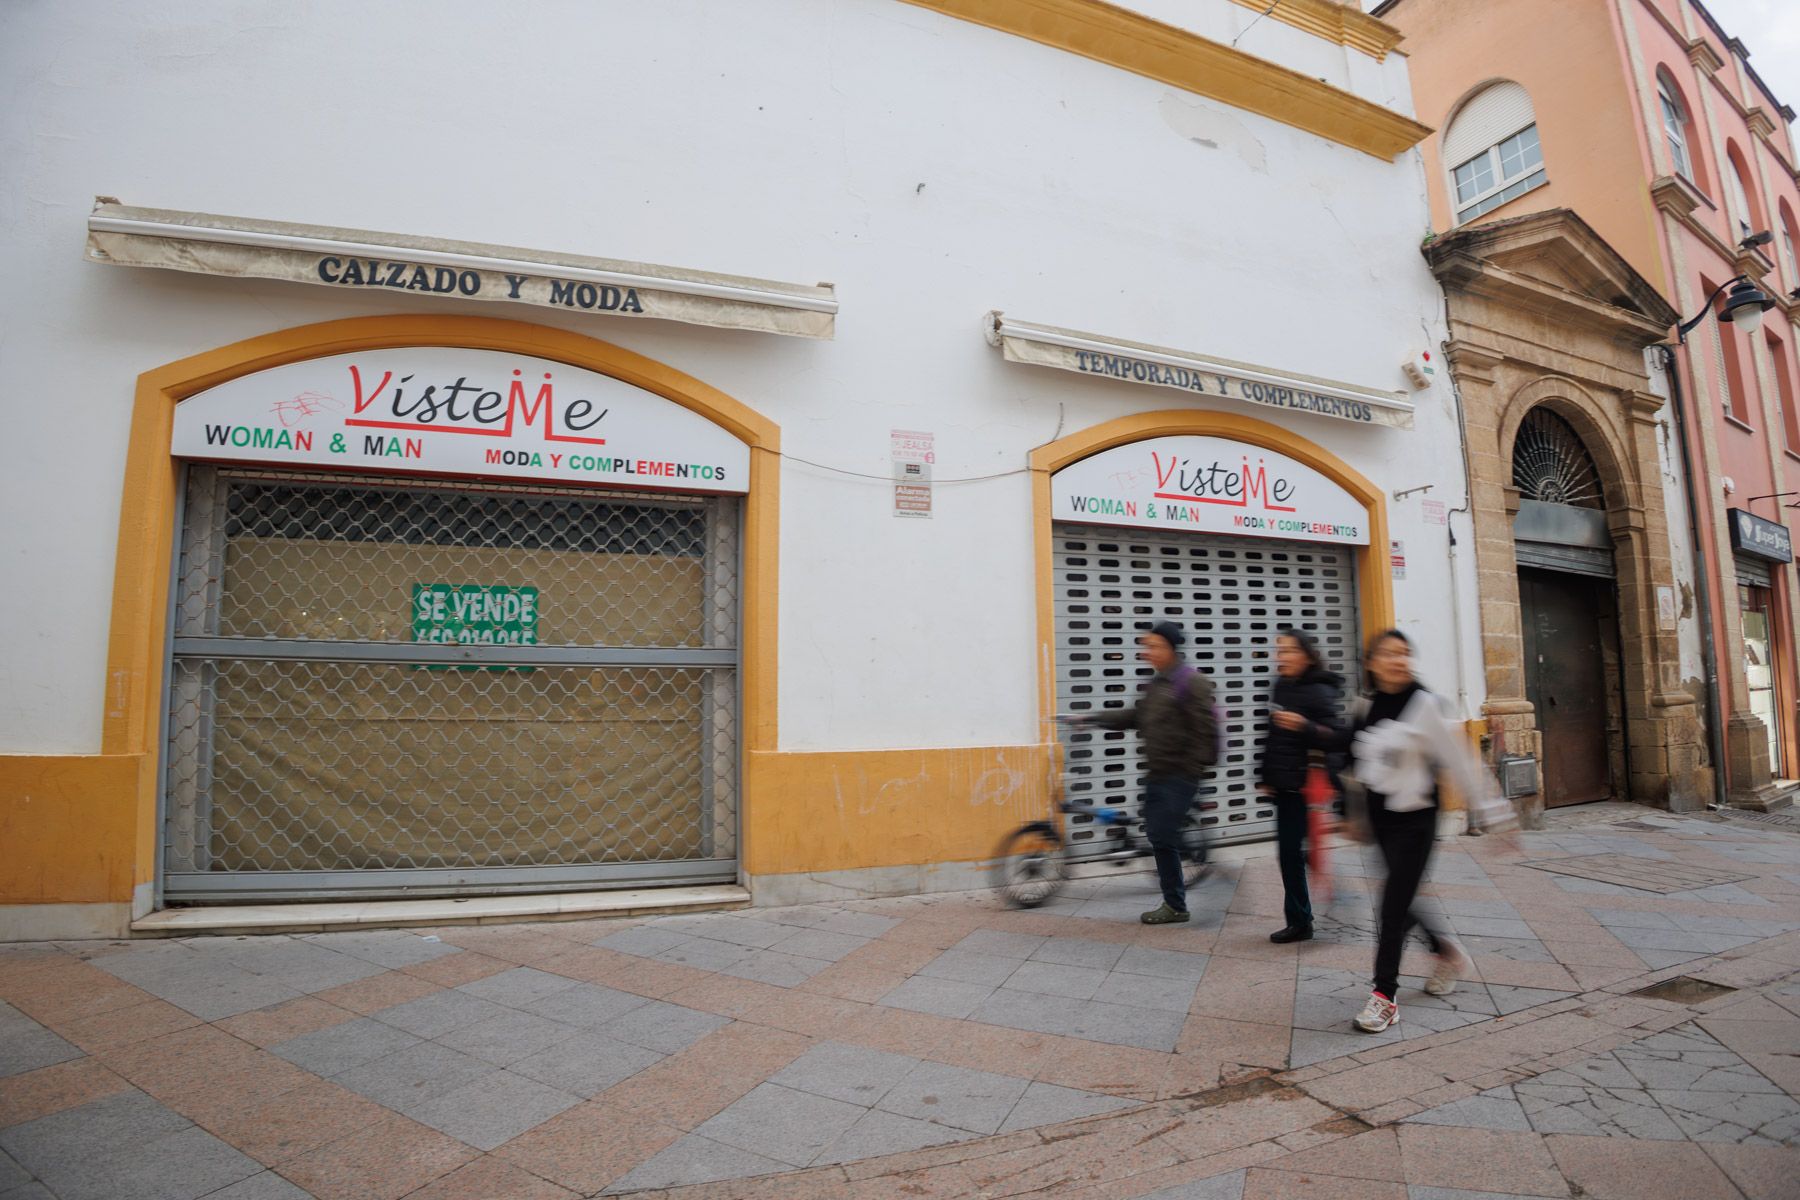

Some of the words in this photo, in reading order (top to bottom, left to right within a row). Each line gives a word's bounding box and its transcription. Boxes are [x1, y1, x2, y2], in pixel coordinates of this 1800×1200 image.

[318, 256, 481, 296] CALZADO
[504, 274, 528, 299] Y
[549, 279, 644, 313] MODA
[1075, 350, 1204, 392] TEMPORADA
[1216, 375, 1229, 395] Y
[1240, 380, 1372, 422] COMPLEMENTOS
[205, 424, 313, 452] WOMAN
[329, 432, 347, 454] &
[364, 435, 422, 459] MAN
[485, 449, 543, 468] MODA
[550, 453, 563, 469] Y
[568, 454, 726, 481] COMPLEMENTOS
[1070, 495, 1137, 518] WOMAN
[1146, 503, 1157, 519] &
[1166, 505, 1200, 523] MAN
[1233, 515, 1265, 529] MODA
[1268, 518, 1276, 530] Y
[1278, 519, 1358, 537] COMPLEMENTOS
[418, 590, 446, 621] SE
[452, 592, 534, 623] VENDE
